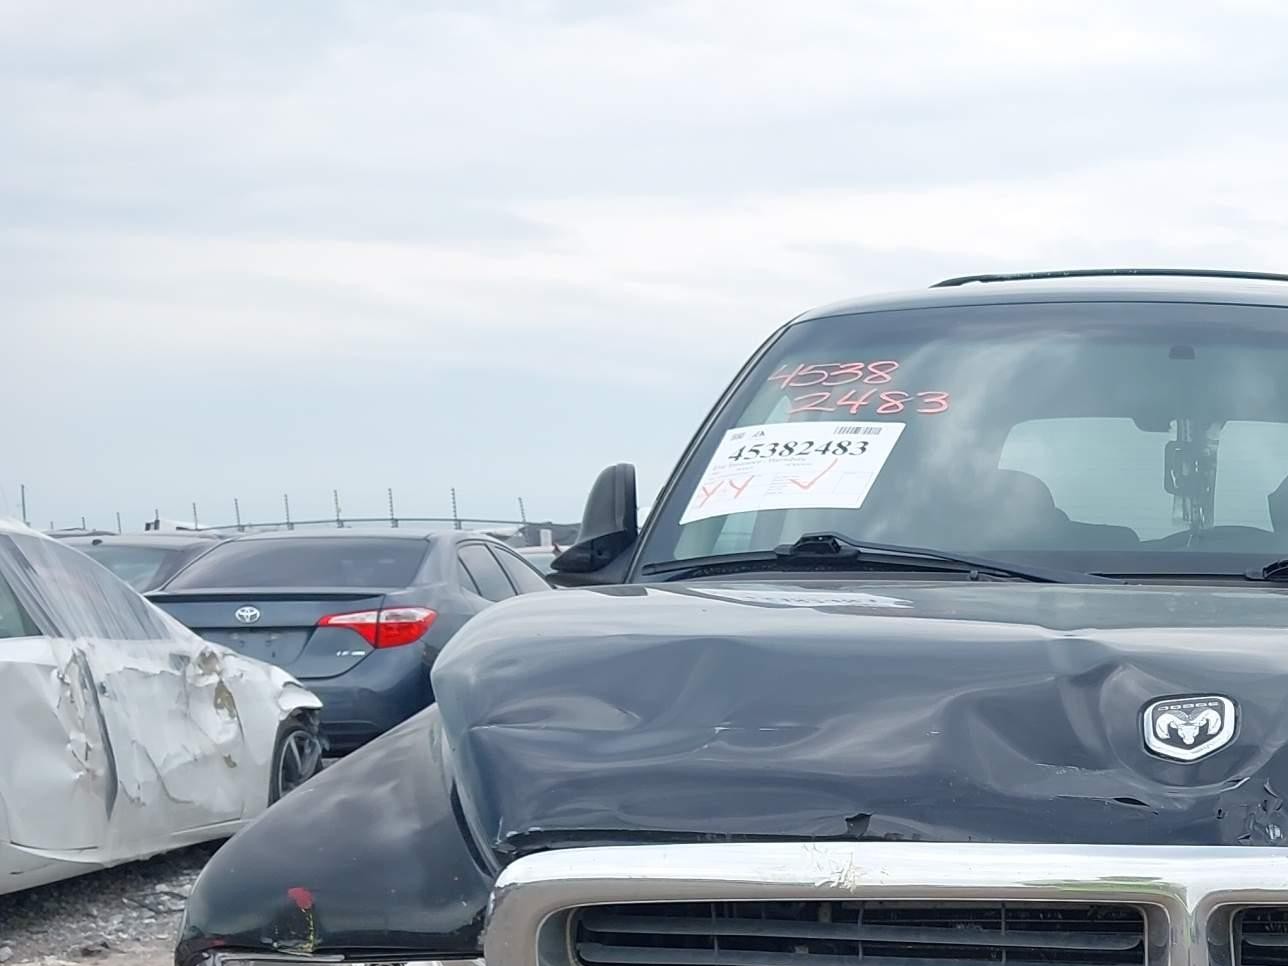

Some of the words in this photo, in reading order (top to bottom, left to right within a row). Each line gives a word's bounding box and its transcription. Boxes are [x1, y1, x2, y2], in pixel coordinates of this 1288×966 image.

[767, 360, 900, 390] 4538
[788, 388, 951, 416] 2483
[728, 439, 870, 462] 45382483
